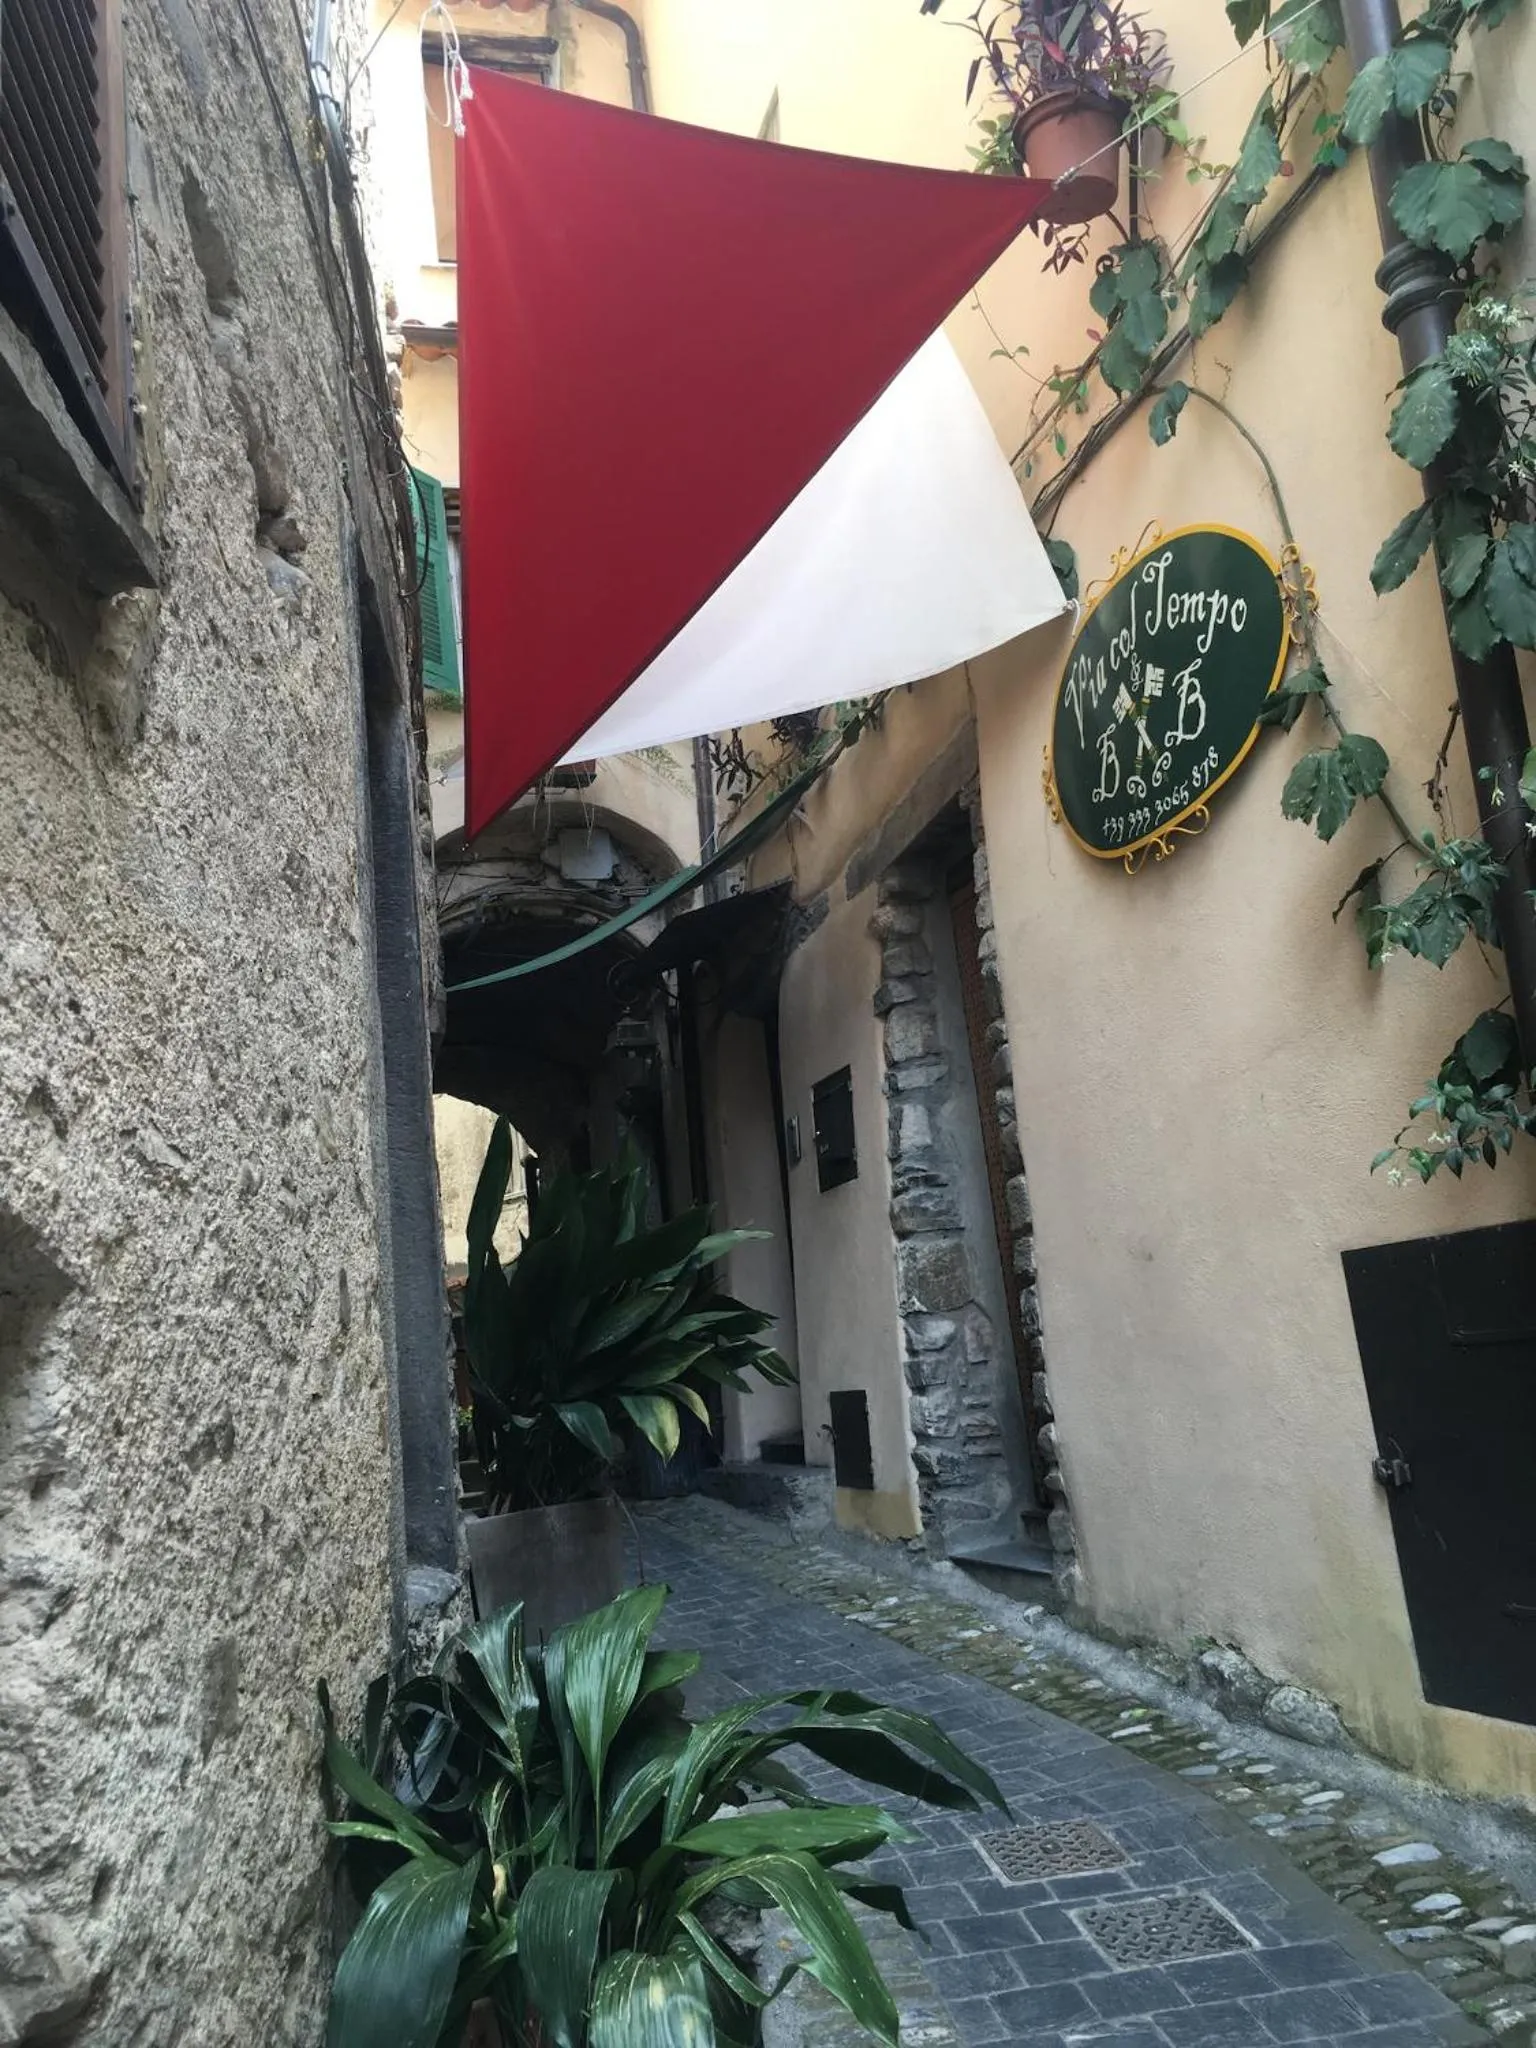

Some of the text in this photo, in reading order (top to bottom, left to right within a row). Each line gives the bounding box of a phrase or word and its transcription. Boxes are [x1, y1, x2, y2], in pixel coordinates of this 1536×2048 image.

[1064, 550, 1247, 750] Via col Tempo
[1092, 652, 1206, 803] B & B
[1102, 745, 1219, 843] +39 333 3065 878
